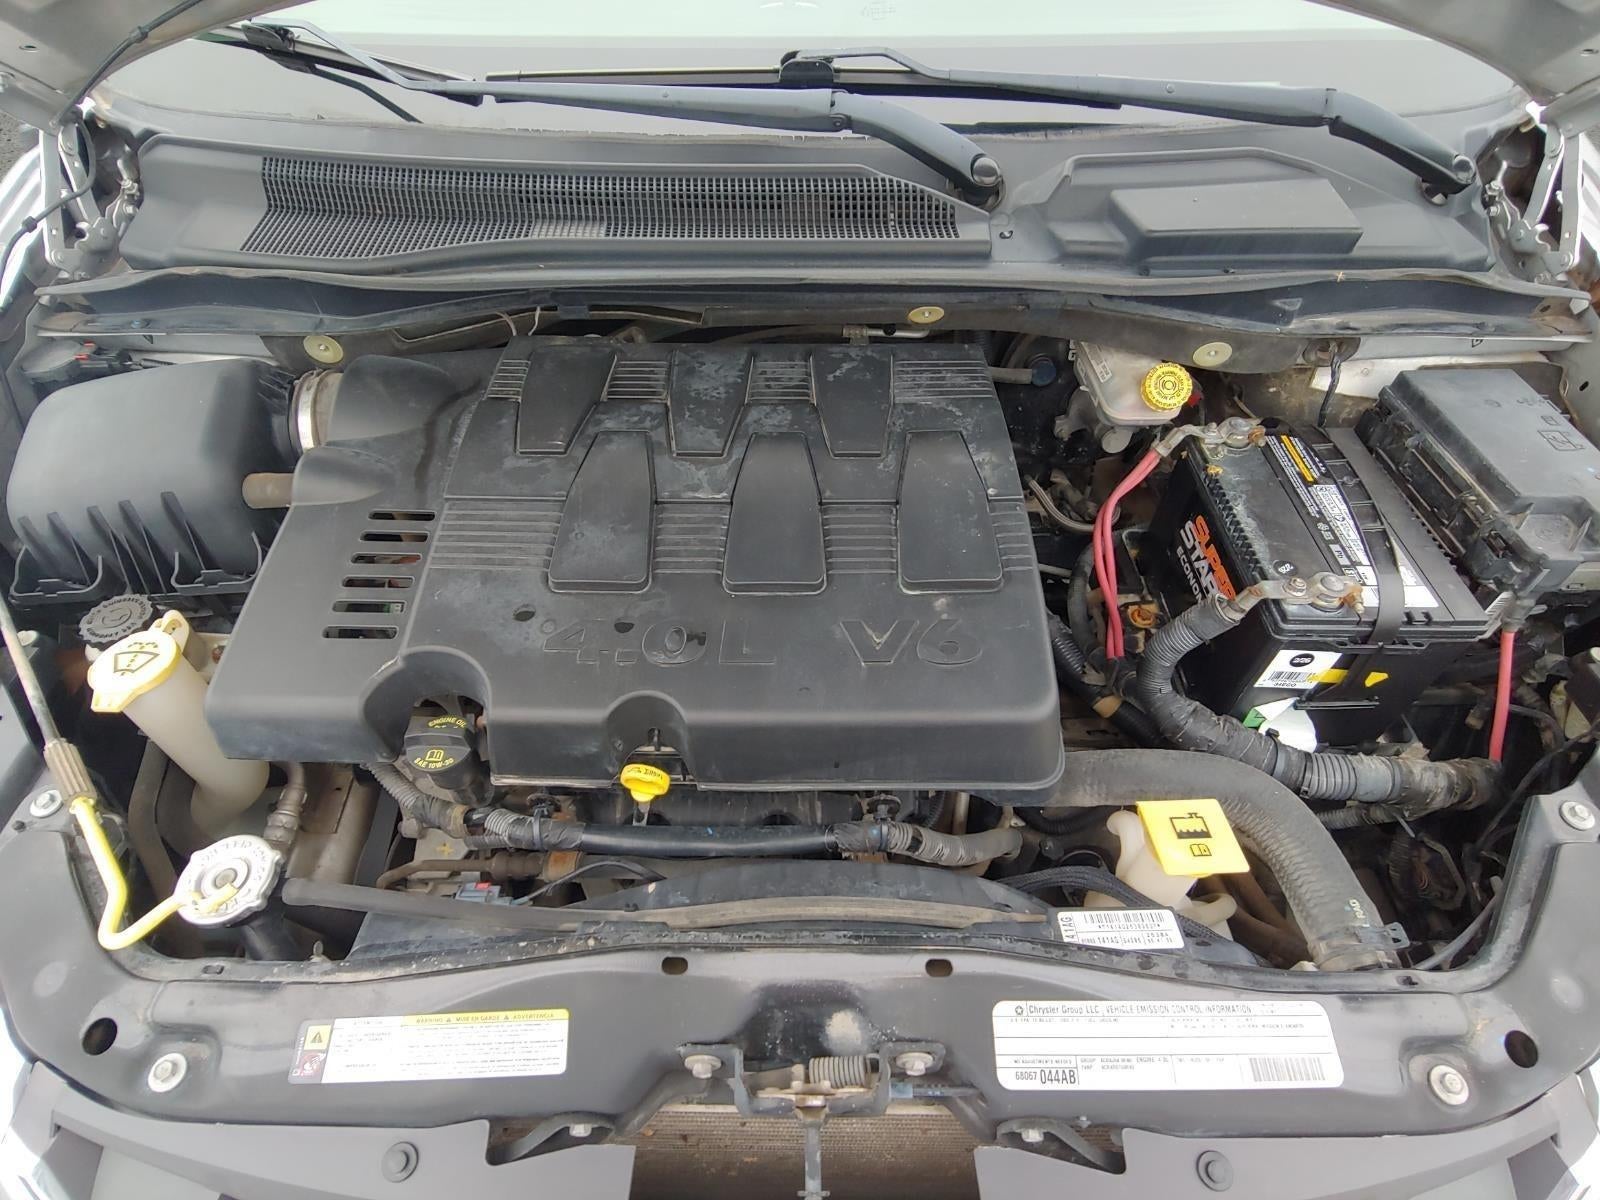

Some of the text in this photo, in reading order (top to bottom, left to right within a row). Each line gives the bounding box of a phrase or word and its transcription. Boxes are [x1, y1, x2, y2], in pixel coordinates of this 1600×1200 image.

[1180, 520, 1219, 597] STAR
[1194, 515, 1236, 601] SUPER
[542, 618, 984, 667] 4.0L V6
[428, 717, 467, 728] ENGINE OIL
[414, 758, 428, 768] SAE
[1028, 1004, 1059, 1016] Chrysler
[1062, 1005, 1083, 1015] Group
[1086, 1004, 1099, 1014] LLC
[1105, 1005, 1133, 1014] VEHICLE
[1136, 1005, 1169, 1014] EMISSION
[1172, 1004, 1202, 1014] CONTROL
[1205, 1004, 1252, 1014] INFORMATION
[1015, 1069, 1076, 1085] 68067 044AB
